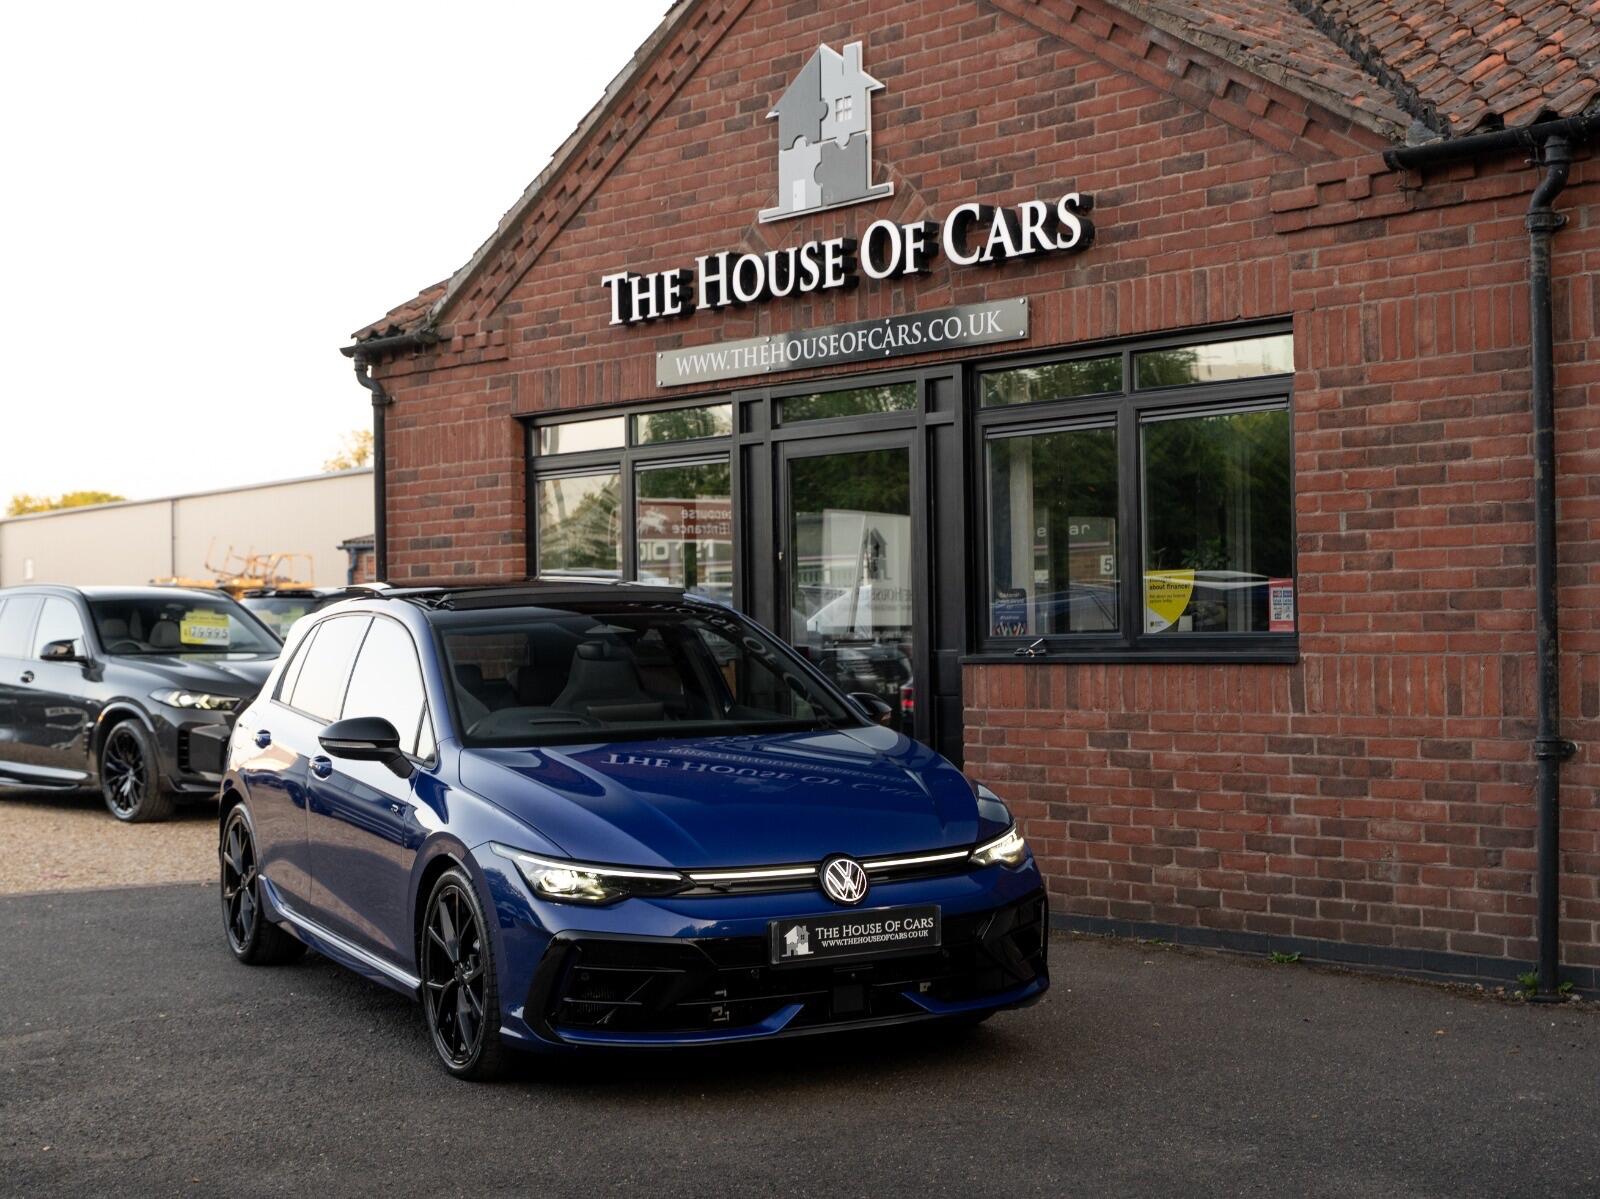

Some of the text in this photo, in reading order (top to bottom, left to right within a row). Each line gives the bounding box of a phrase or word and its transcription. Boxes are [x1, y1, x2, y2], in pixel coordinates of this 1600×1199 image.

[602, 192, 1083, 325] THE HOUSE OF CARS
[675, 310, 1003, 377] WWW.THEHOUSEOFCARS.CO.UK
[815, 917, 934, 940] THE HOUSE OF CARS
